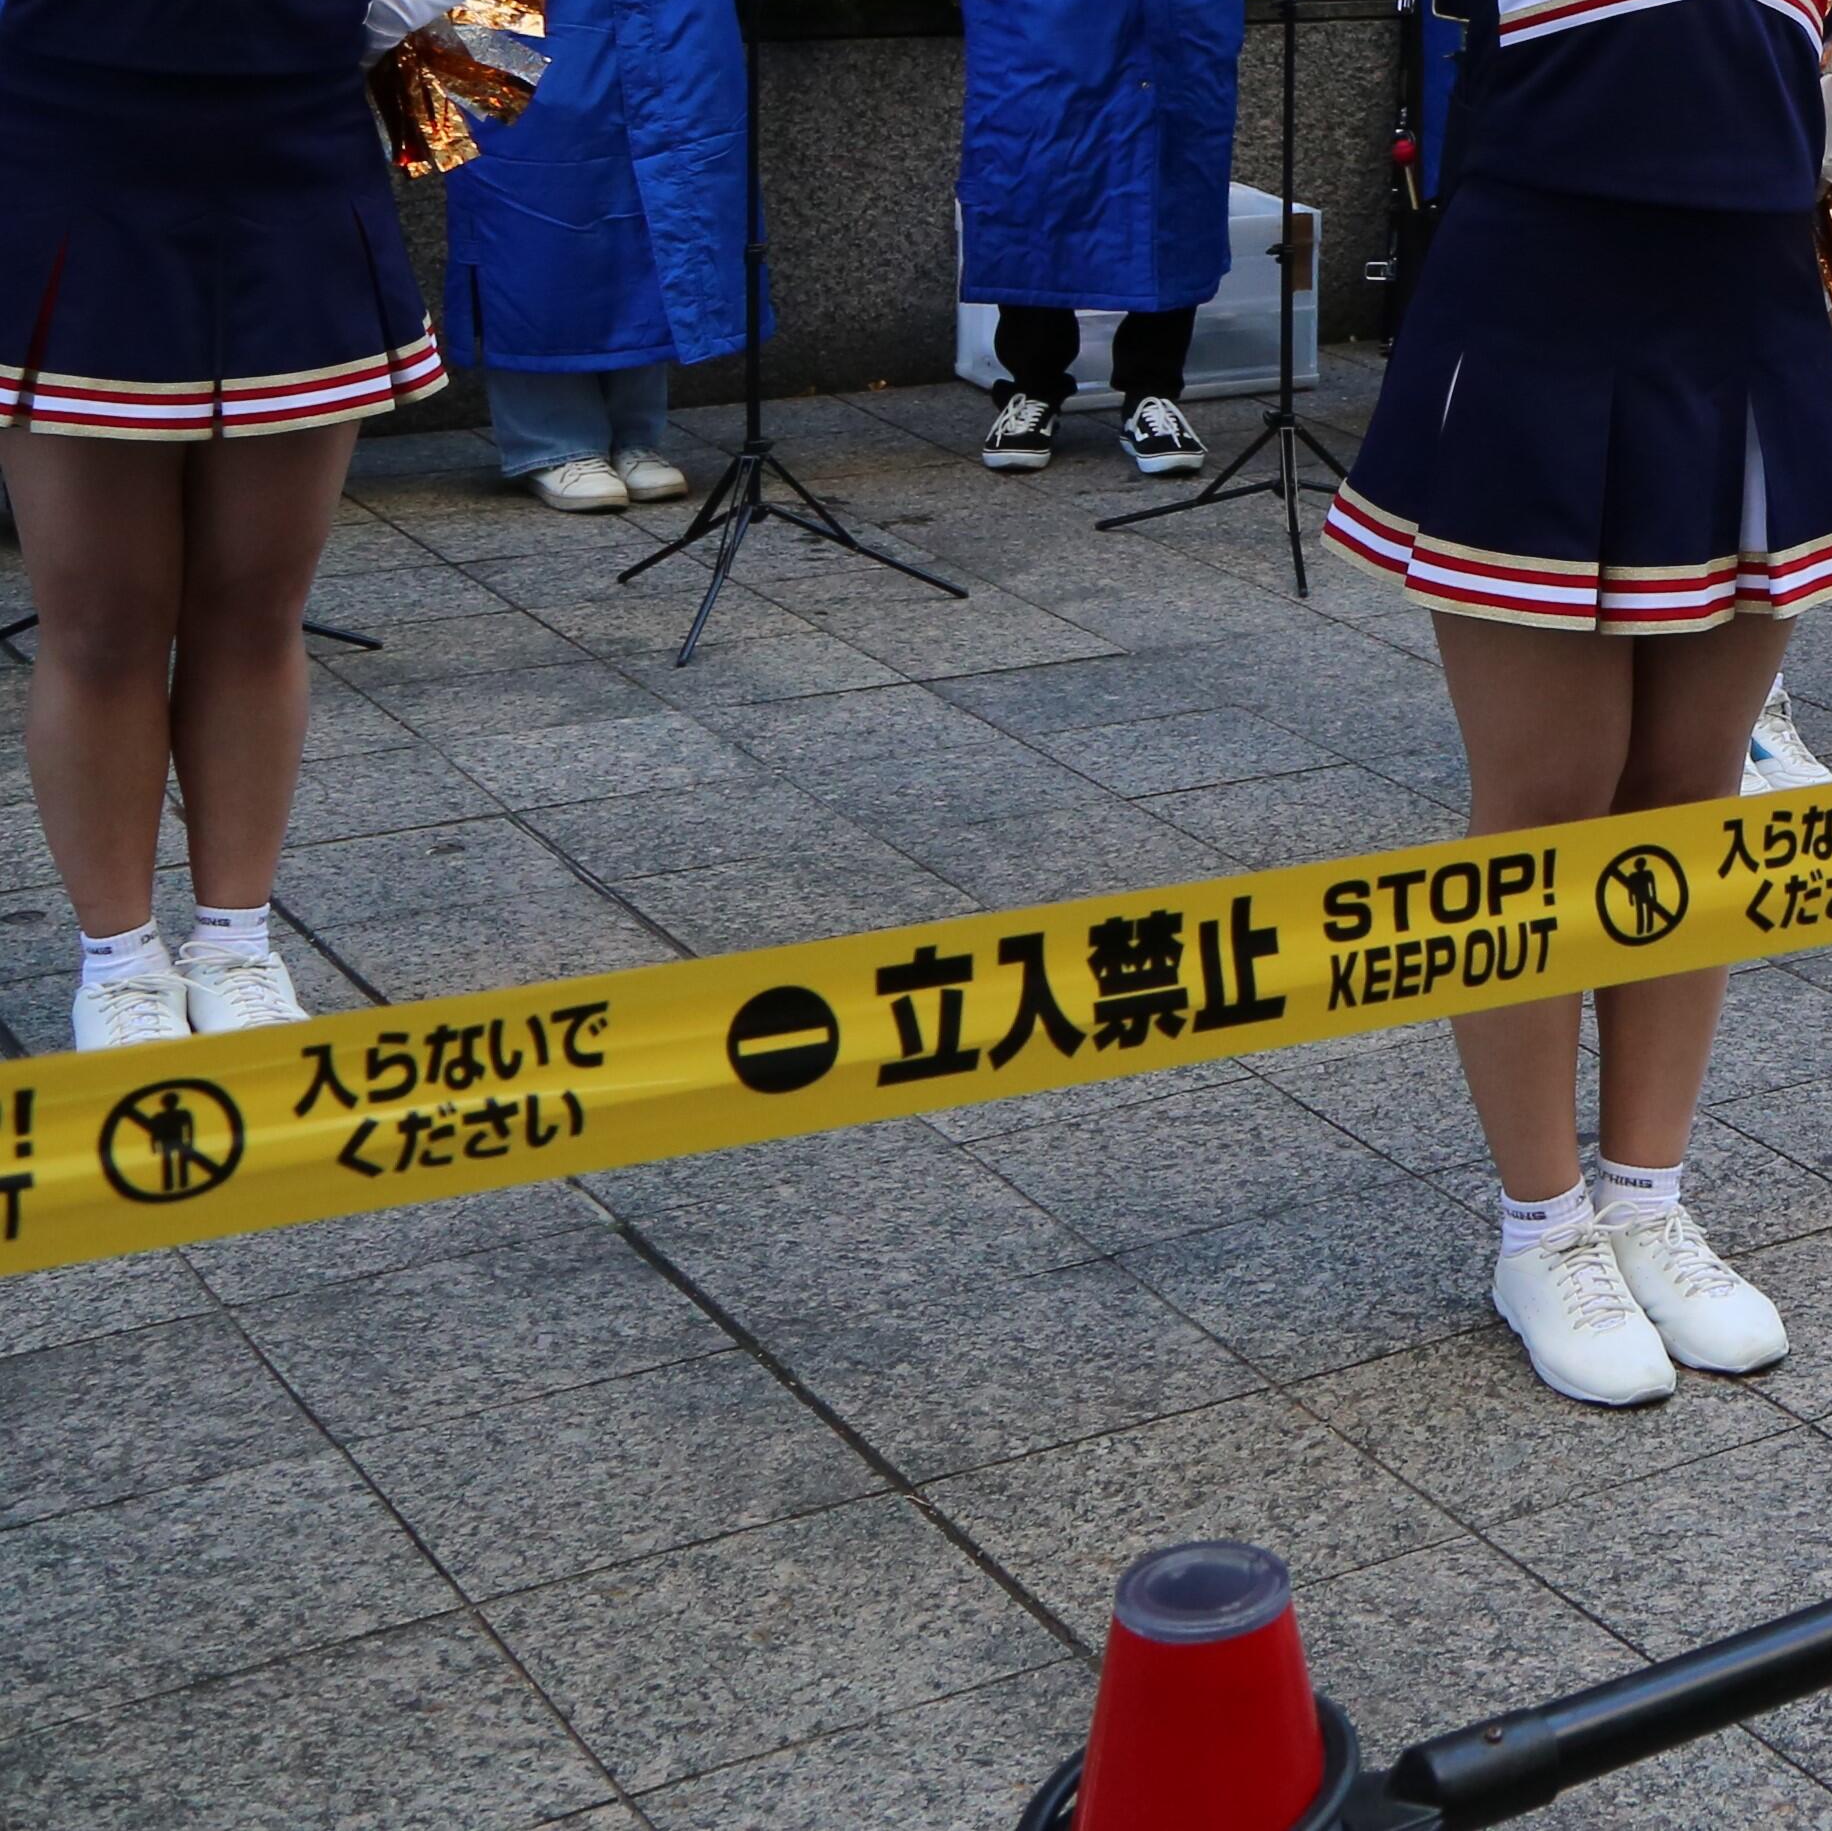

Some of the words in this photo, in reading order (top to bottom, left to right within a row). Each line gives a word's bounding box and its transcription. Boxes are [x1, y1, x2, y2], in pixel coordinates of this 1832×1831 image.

[1323, 848, 1556, 942] STOP!
[875, 895, 1287, 1087] 立入禁止
[294, 1000, 609, 1117] 入らないで
[336, 1091, 585, 1178] ください
